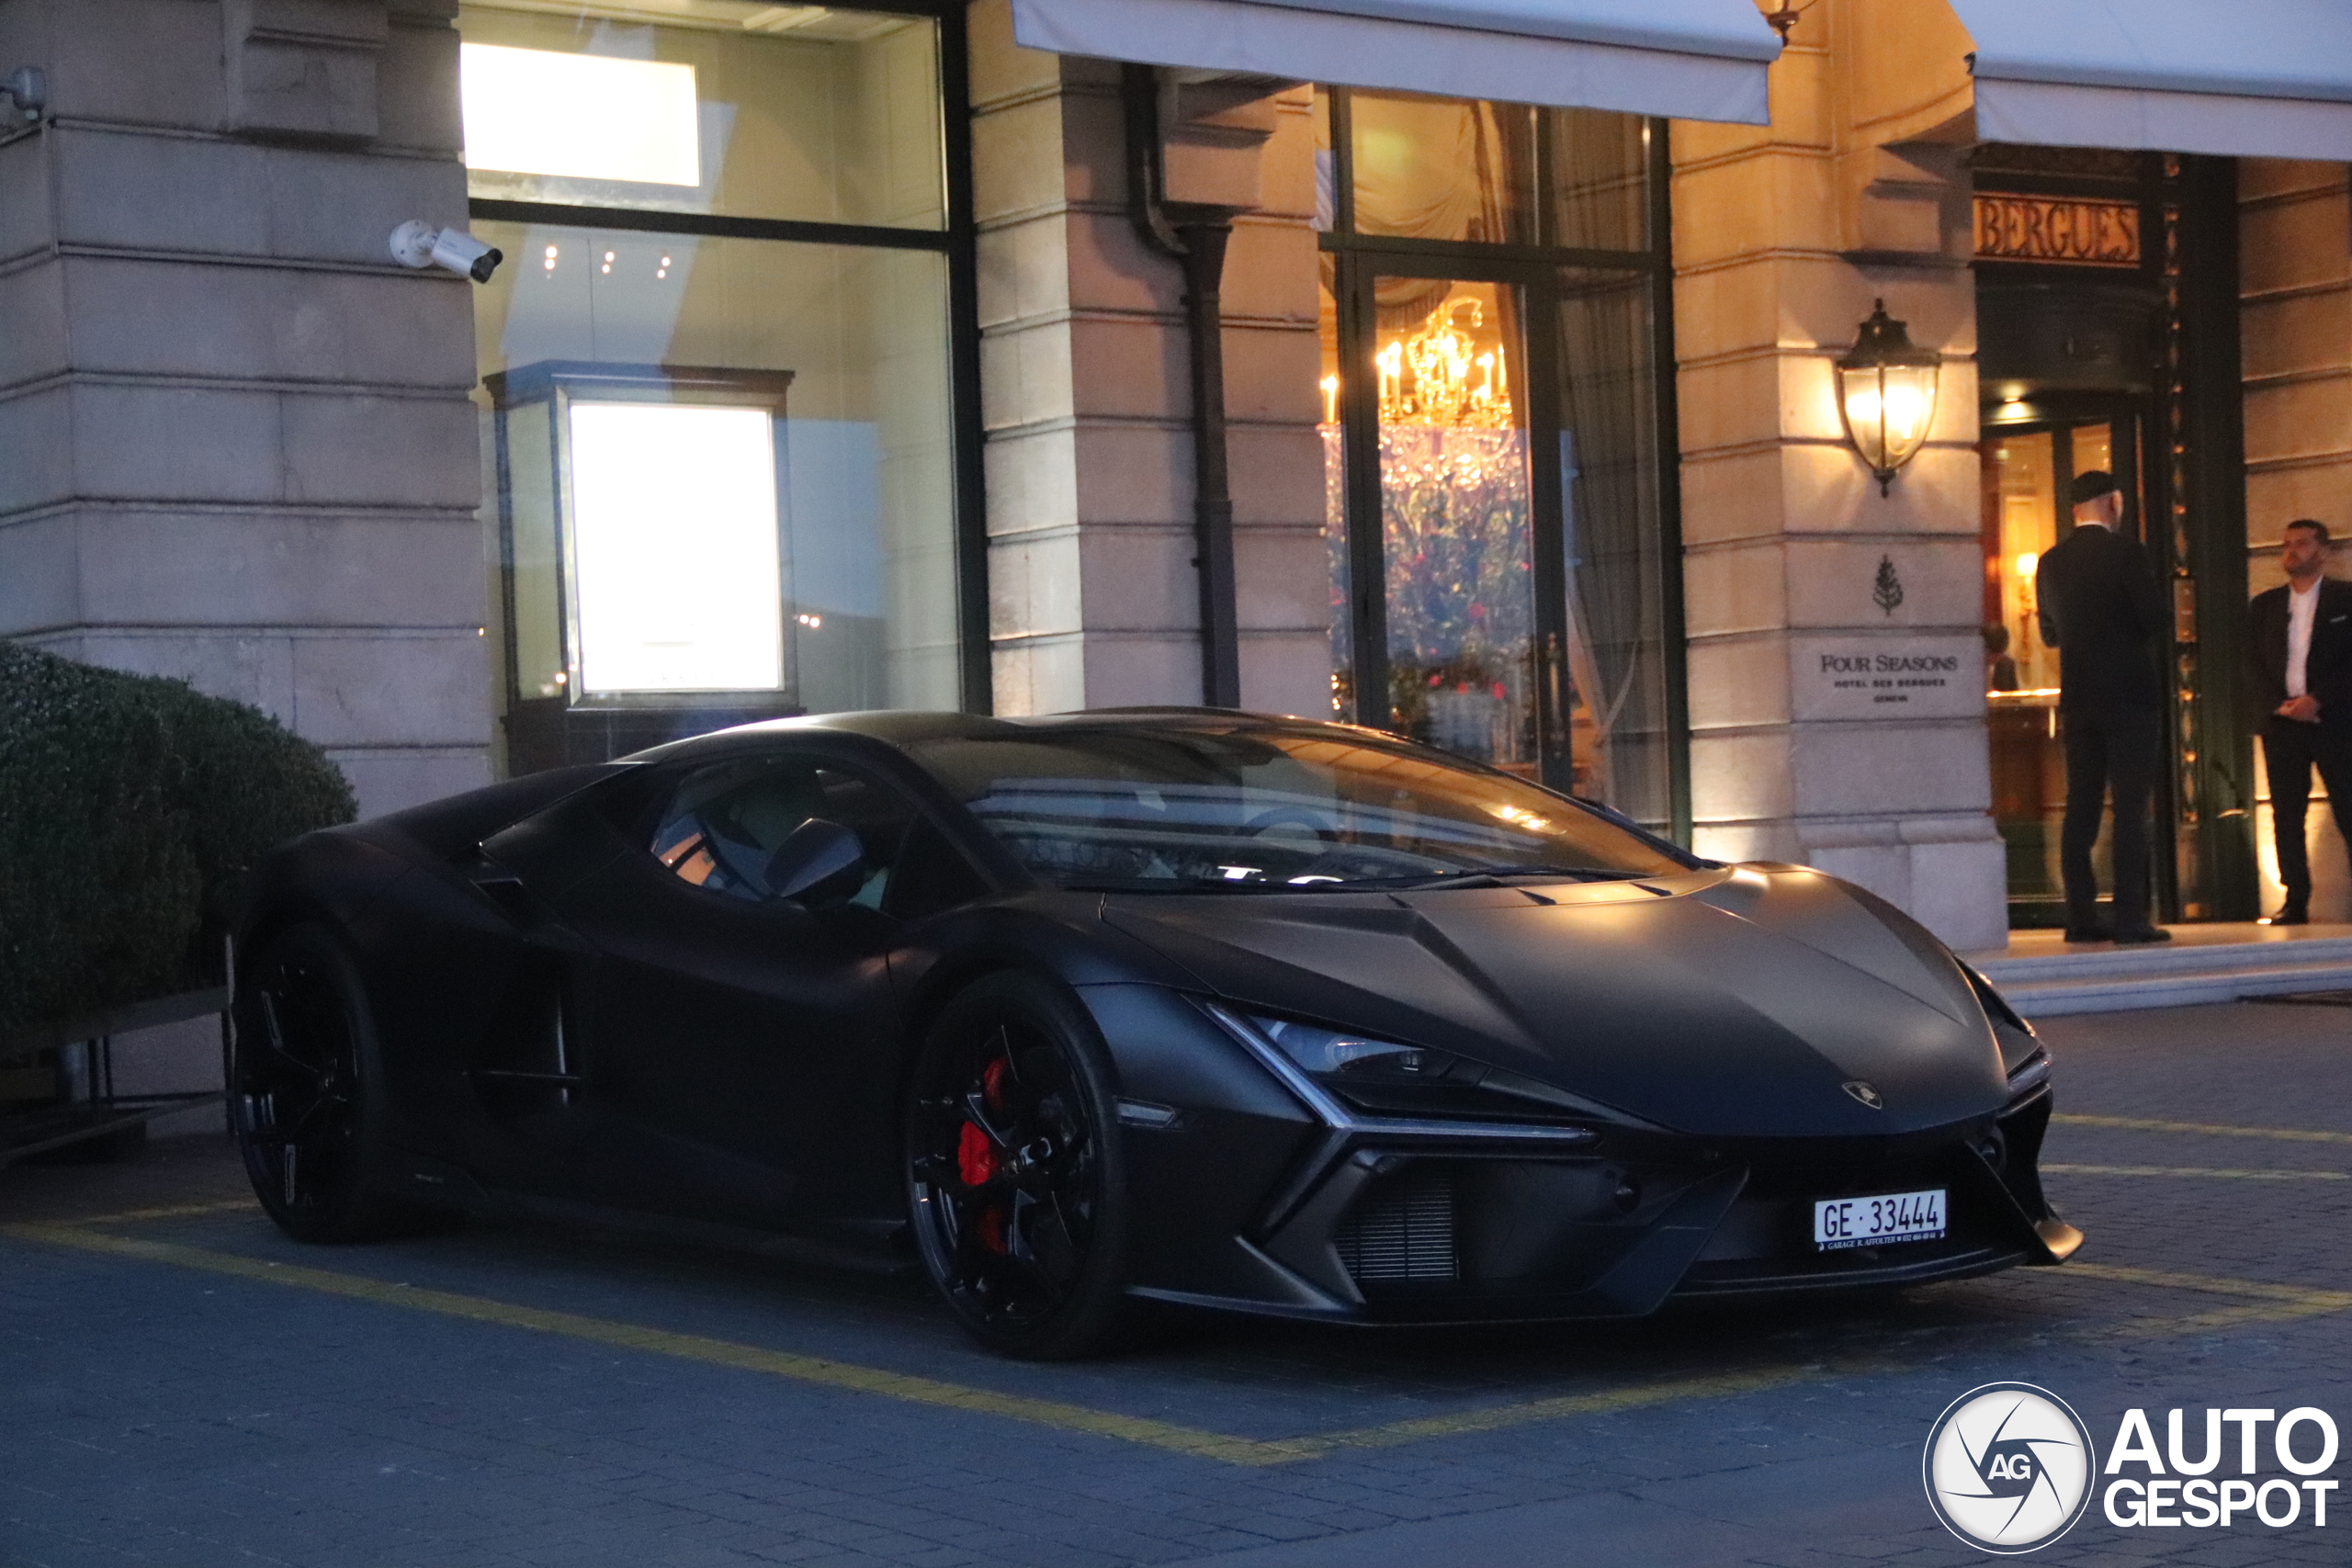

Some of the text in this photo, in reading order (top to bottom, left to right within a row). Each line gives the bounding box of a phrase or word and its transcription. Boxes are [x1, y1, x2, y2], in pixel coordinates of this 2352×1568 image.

[1979, 199, 2134, 261] BERGUES
[1821, 654, 1958, 672] FOUR SEASONS
[1834, 680, 1868, 688] HOTEL
[1872, 679, 1893, 688] DES
[1870, 1195, 1938, 1234] 33444
[1827, 1241, 1855, 1250] GARAGE
[1865, 1235, 1896, 1247] AFFOLTER
